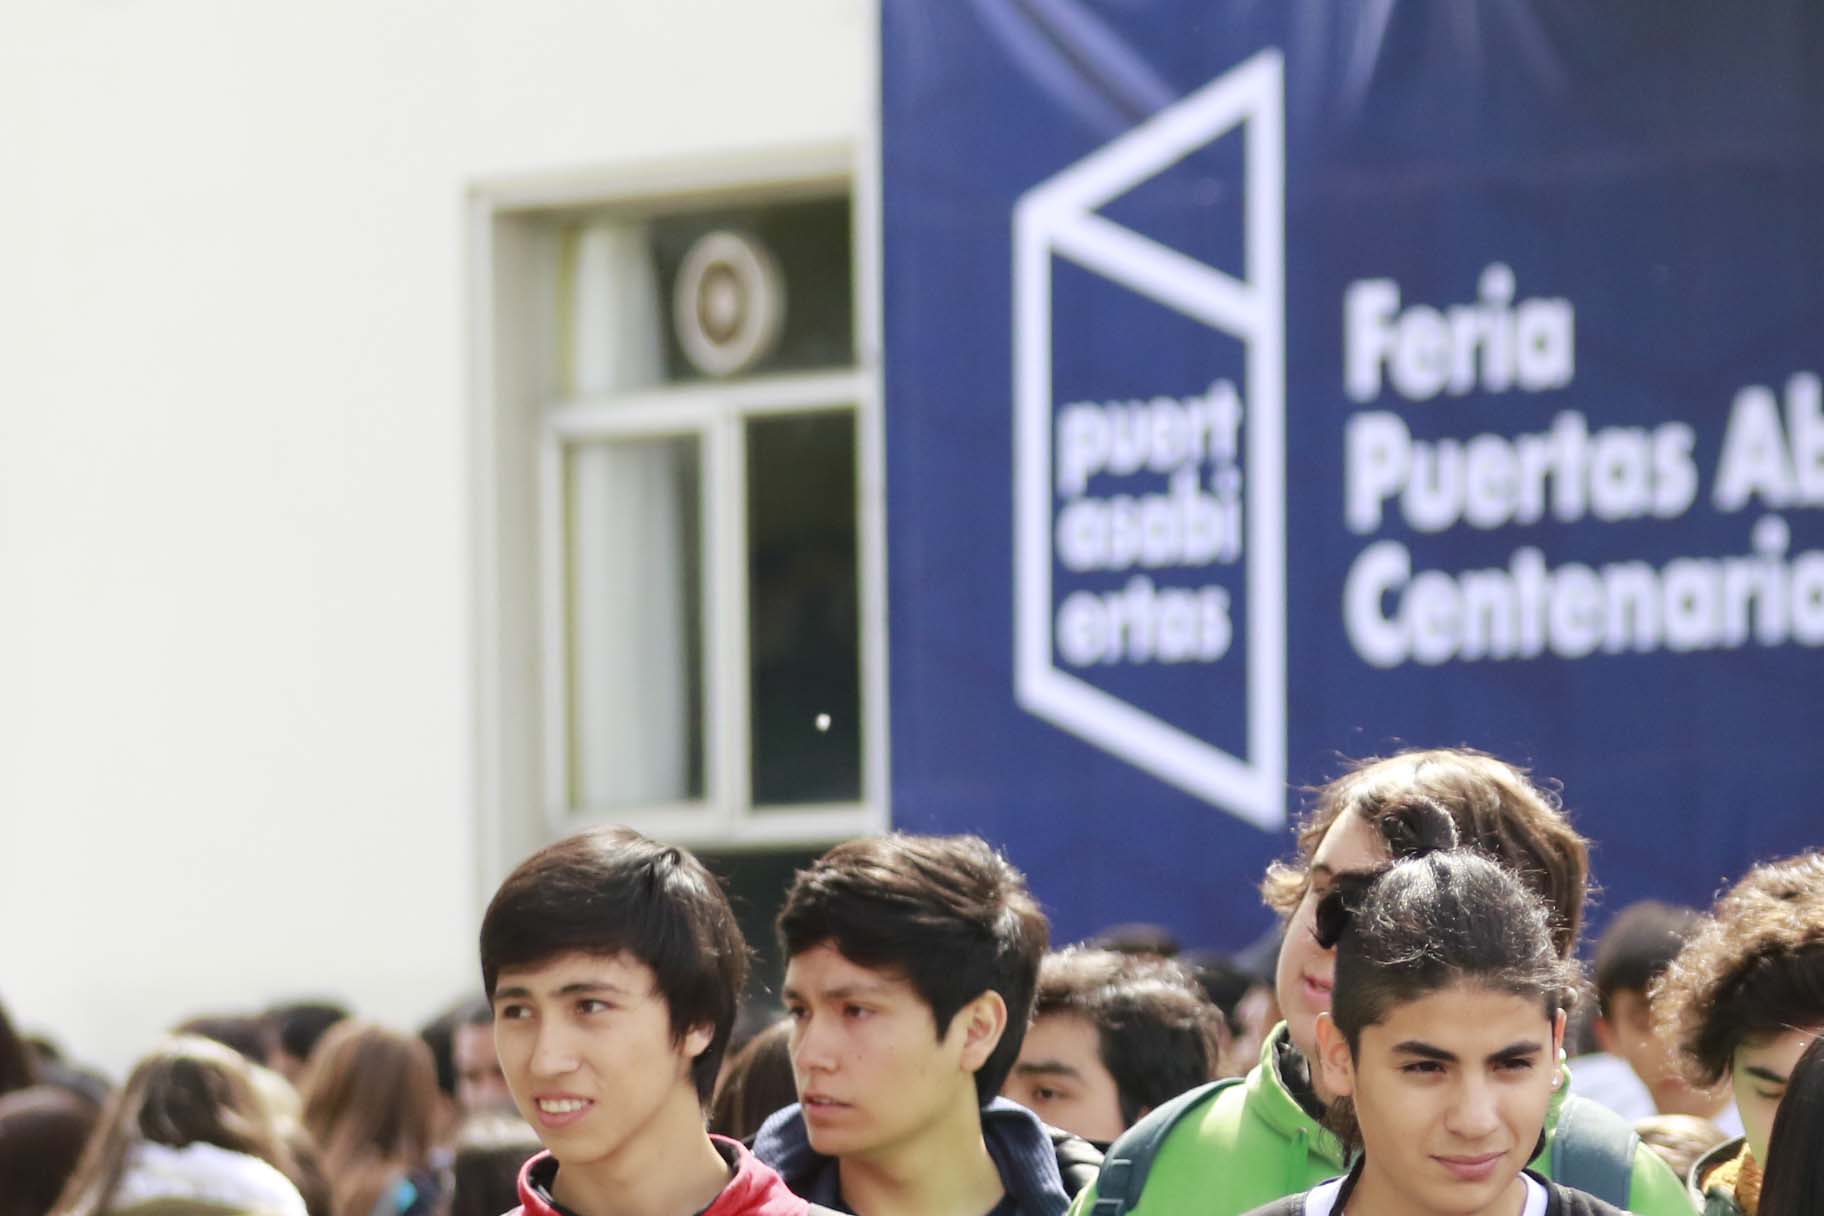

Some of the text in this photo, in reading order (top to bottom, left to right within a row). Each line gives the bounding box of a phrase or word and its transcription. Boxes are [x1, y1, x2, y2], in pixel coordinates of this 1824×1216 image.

[1344, 262, 1575, 402] Feria
[1057, 378, 1243, 498] puert
[1345, 410, 1698, 535] Puertas
[1056, 464, 1242, 571] asabi
[1056, 573, 1232, 666] ertas
